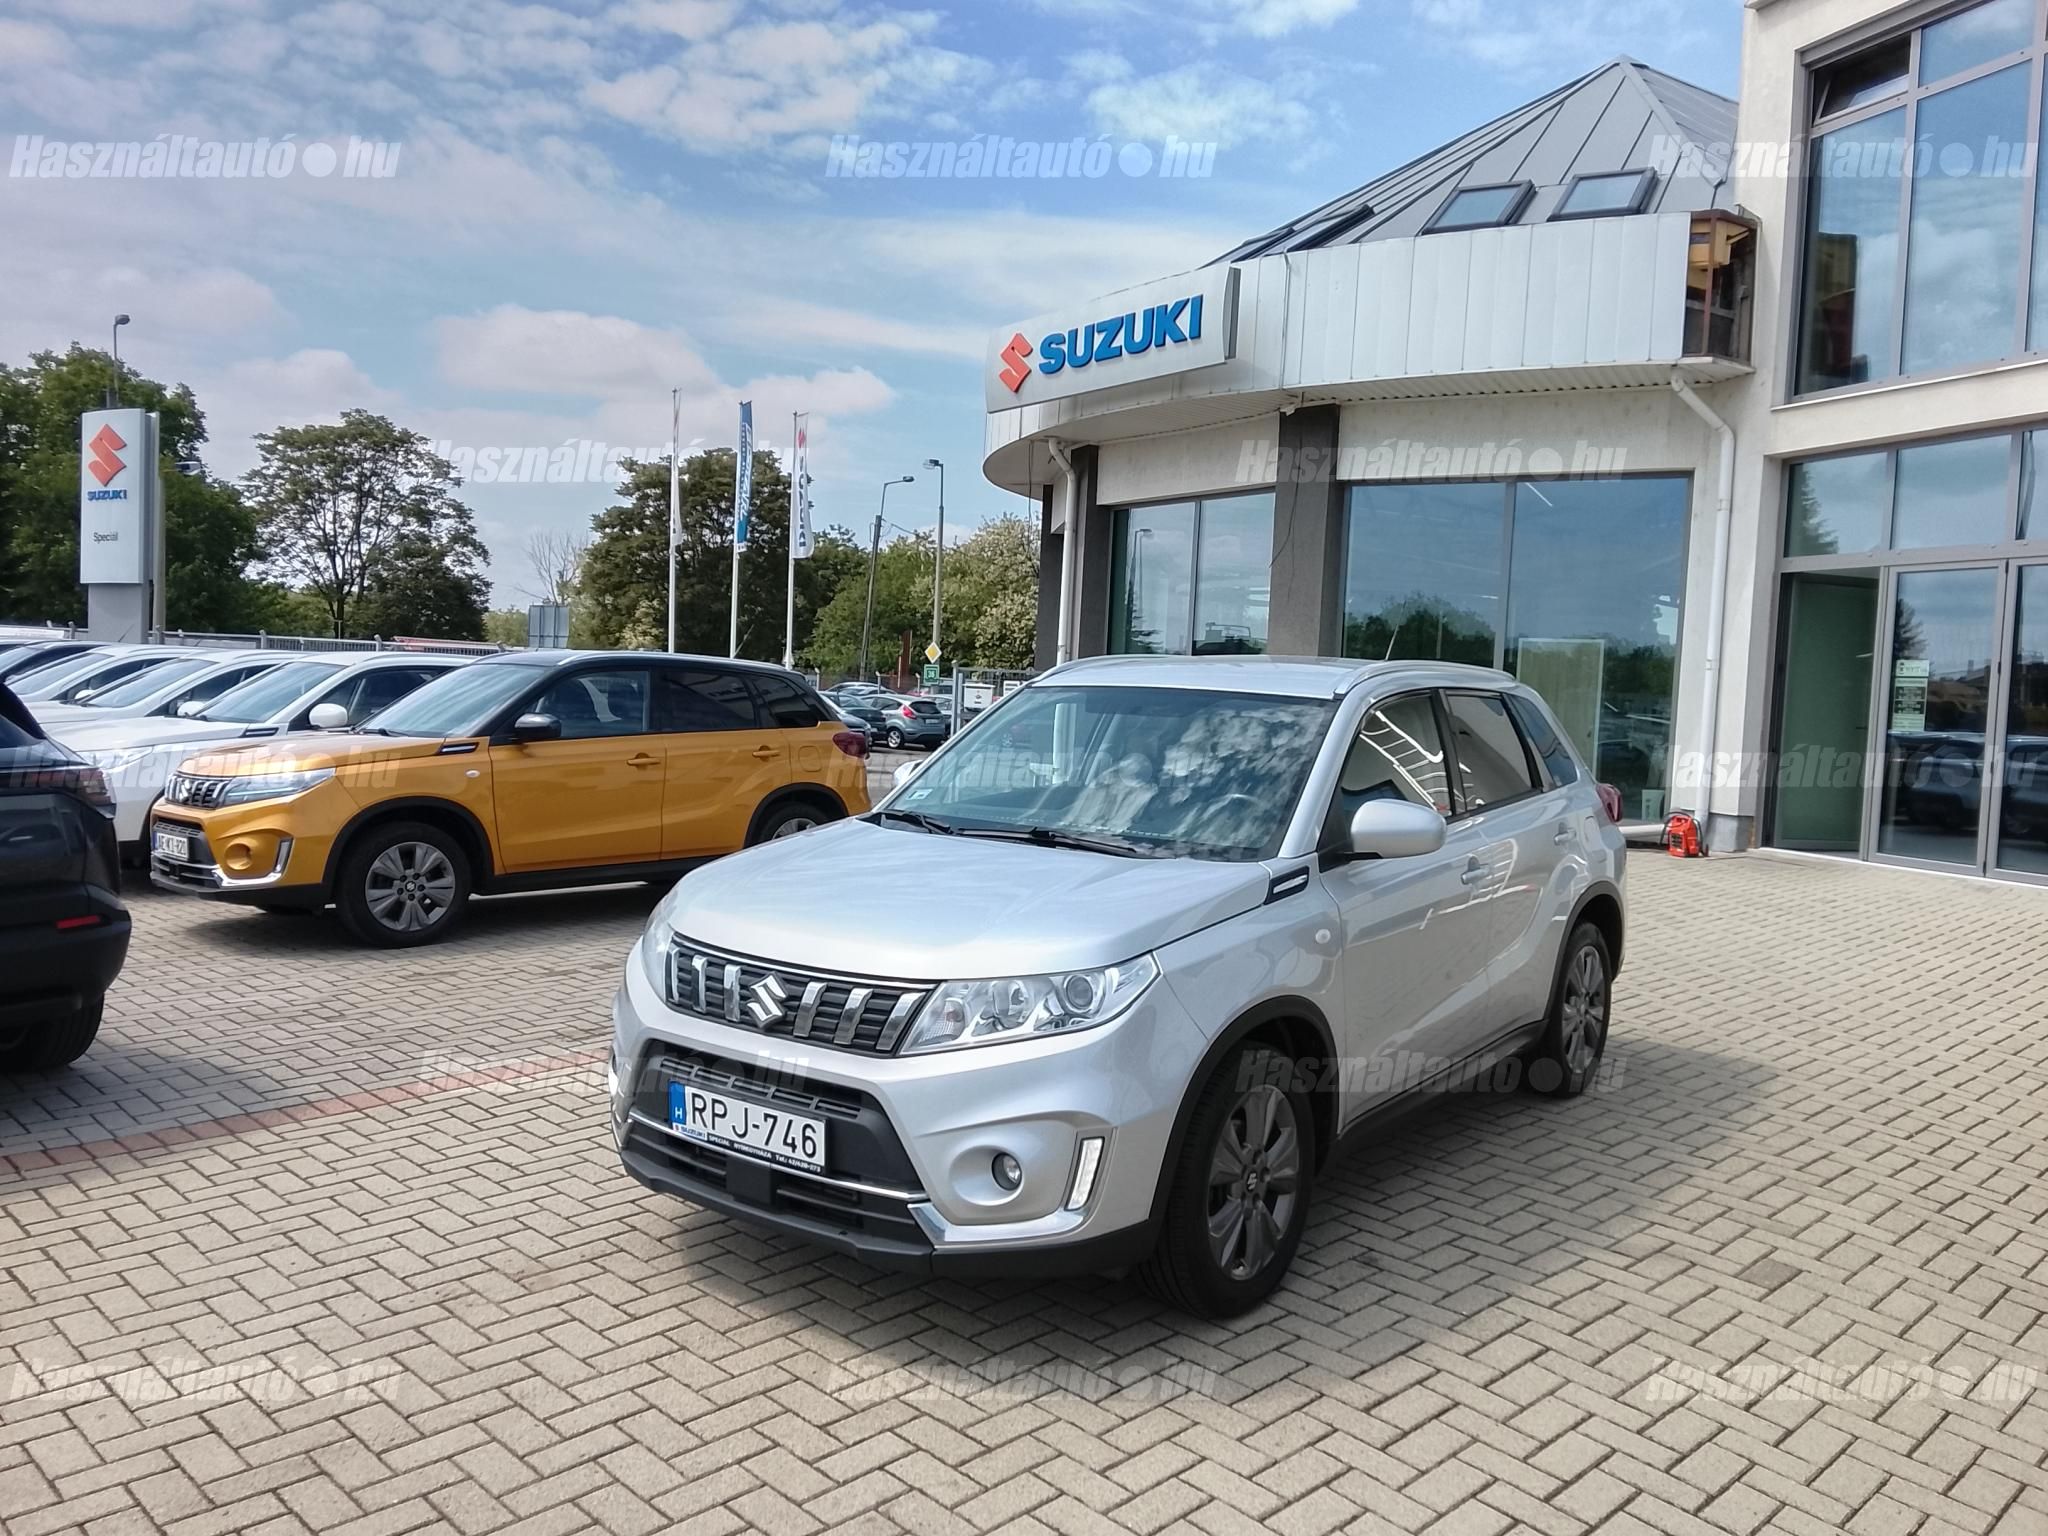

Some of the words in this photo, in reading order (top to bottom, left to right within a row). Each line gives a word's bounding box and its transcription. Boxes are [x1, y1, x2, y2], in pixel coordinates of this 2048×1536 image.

[1038, 294, 1204, 376] SUZUKI
[87, 489, 128, 501] SUZUKI
[674, 1108, 683, 1120] H
[691, 1092, 817, 1159] RPJ-746
